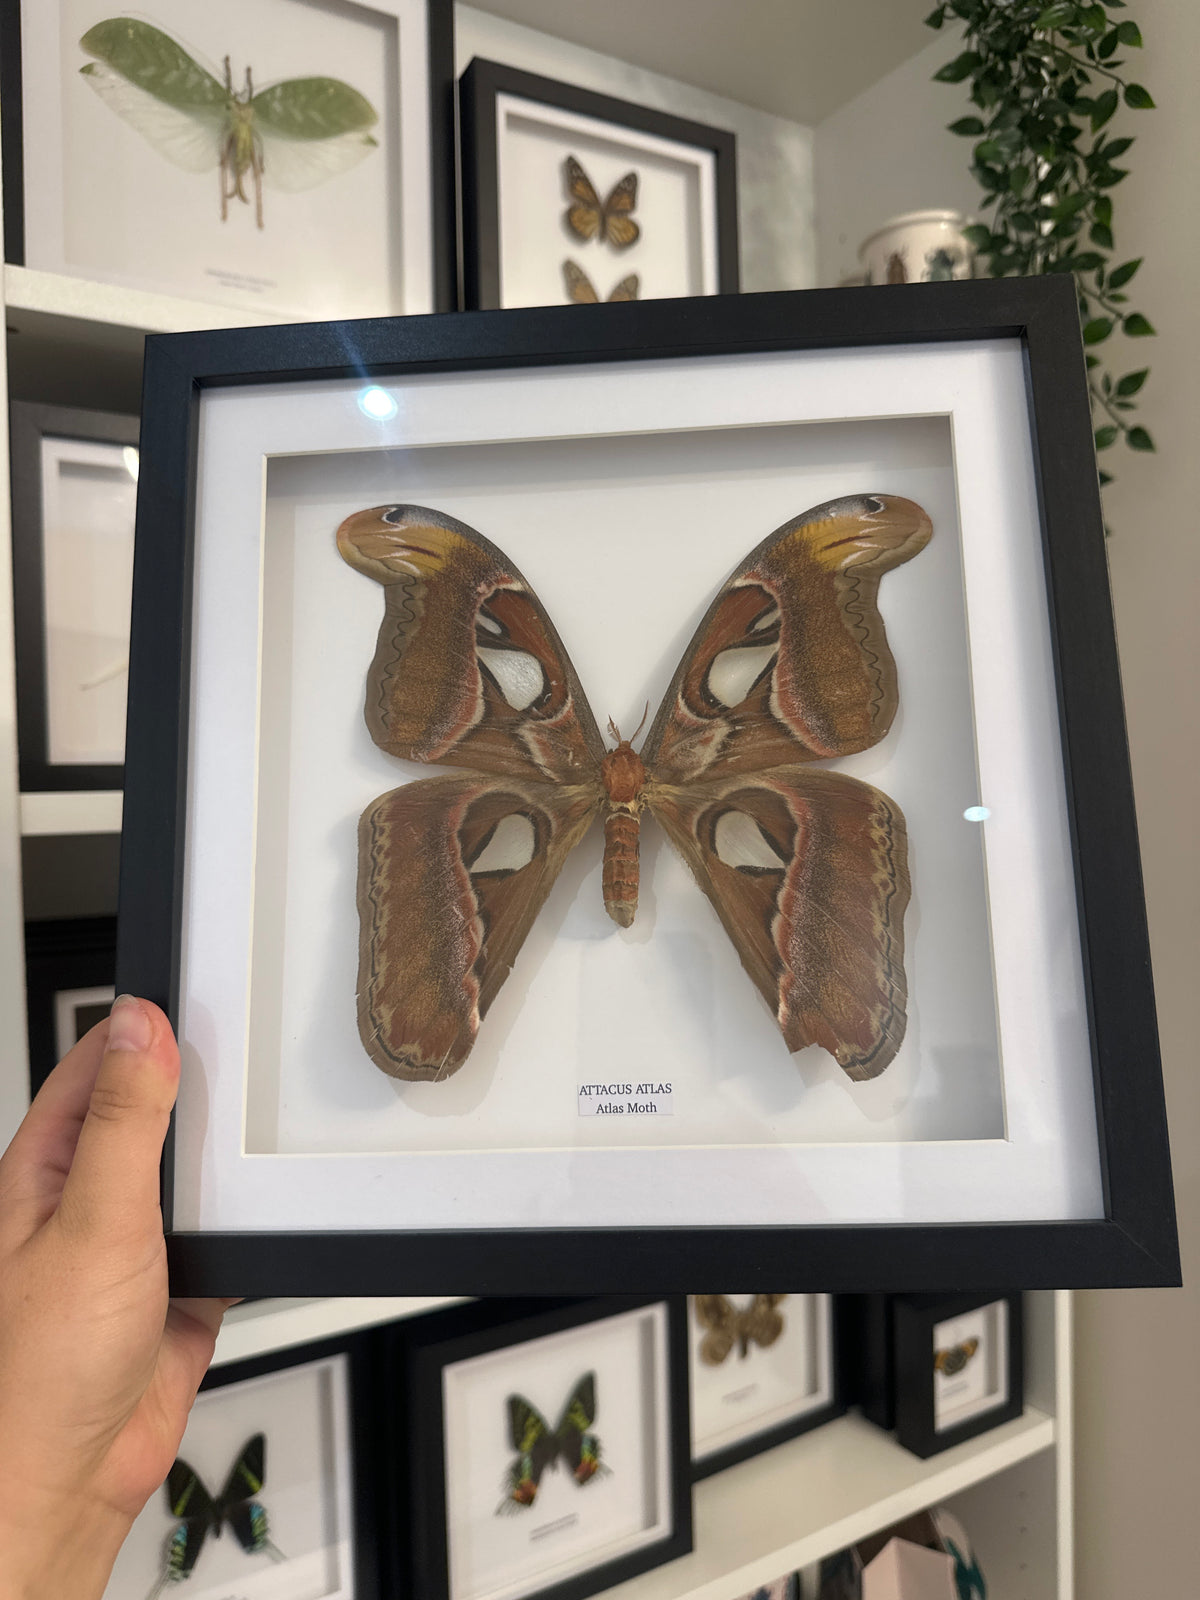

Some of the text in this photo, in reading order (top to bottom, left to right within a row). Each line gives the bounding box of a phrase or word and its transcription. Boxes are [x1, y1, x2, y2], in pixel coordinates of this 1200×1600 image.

[579, 1083, 672, 1095] ATTACUS ATLAS
[596, 1101, 657, 1114] Atlas Moth
